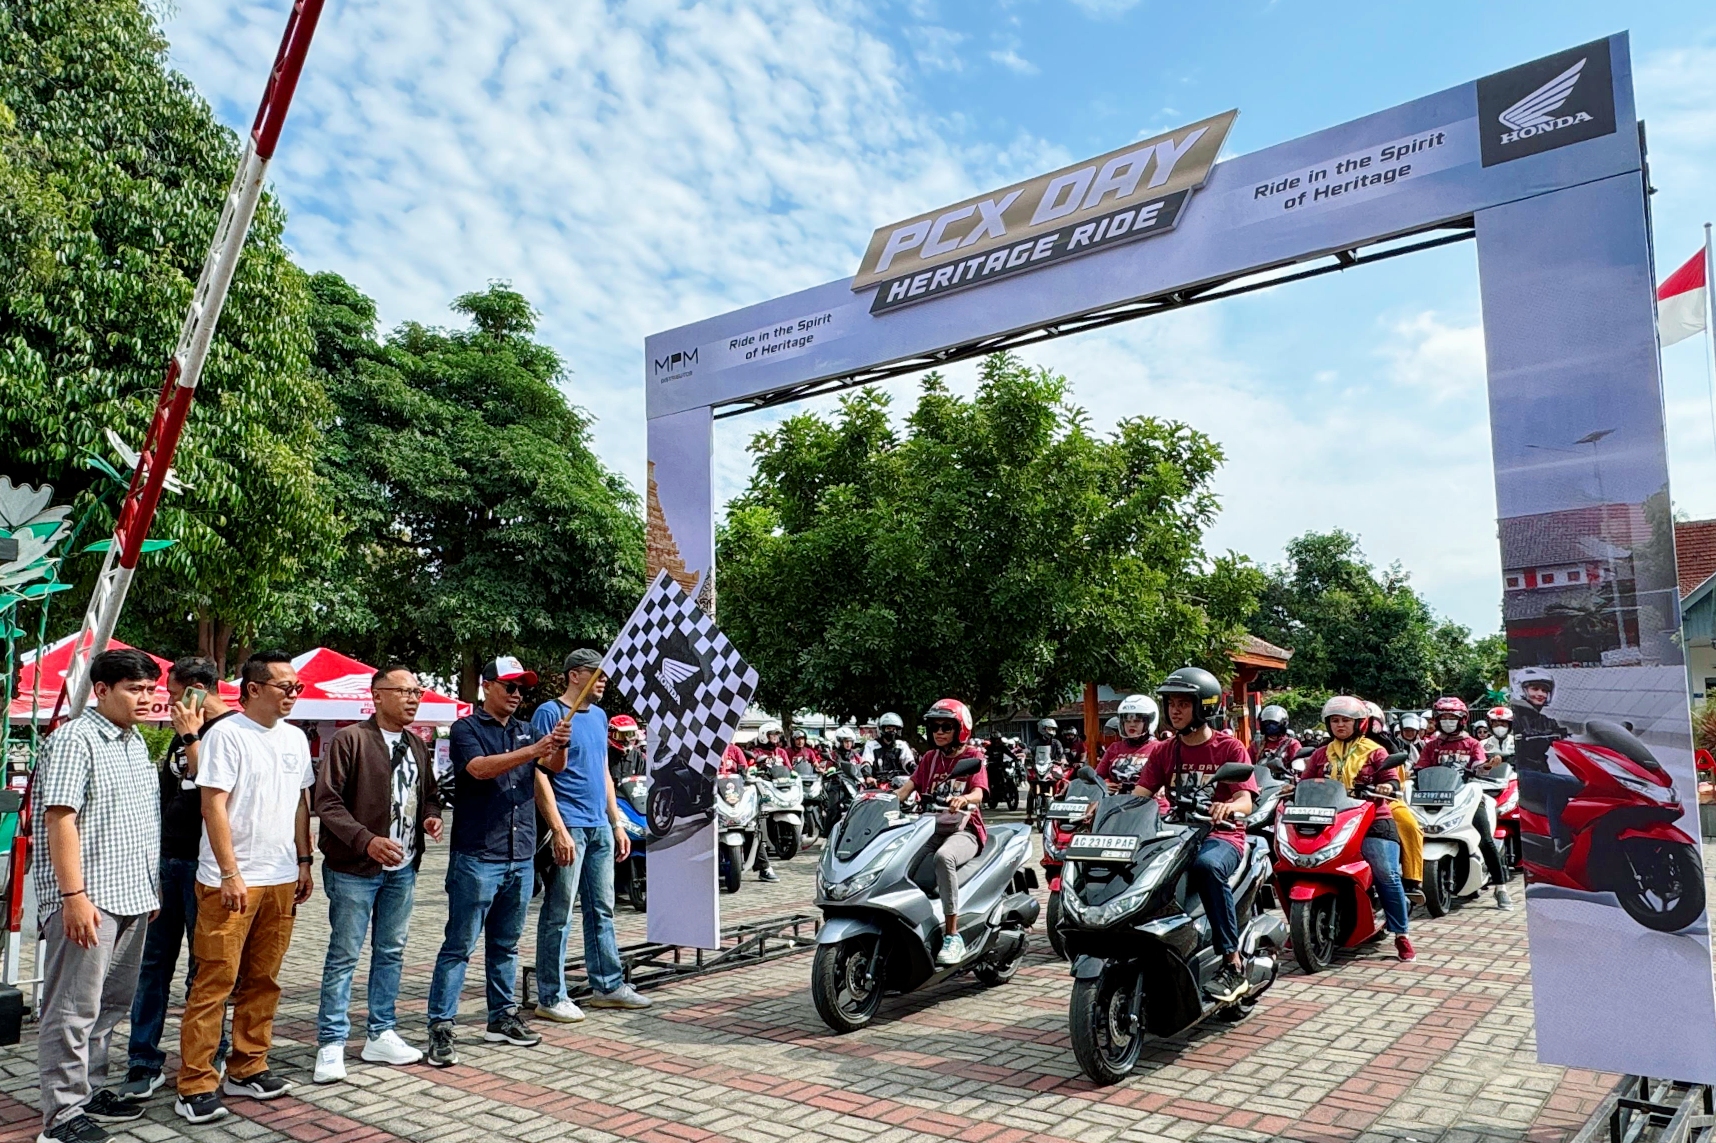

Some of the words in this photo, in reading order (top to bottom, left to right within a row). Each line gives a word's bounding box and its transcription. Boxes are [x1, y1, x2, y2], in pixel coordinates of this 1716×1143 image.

[1500, 111, 1594, 145] HONDA
[1254, 177, 1301, 200] Ride
[1308, 169, 1327, 184] in
[1335, 155, 1372, 175] the
[1379, 131, 1445, 161] Spirit
[874, 188, 1025, 274] PCX
[1029, 126, 1210, 227] DAY
[1284, 191, 1307, 210] of
[1313, 164, 1412, 201] Heritage
[886, 233, 1060, 303] HERITAGE
[1066, 200, 1165, 251] RIDE
[729, 335, 755, 350] Ride
[759, 332, 770, 342] in
[773, 325, 793, 338] the
[797, 313, 832, 331] Spirit
[745, 347, 758, 360] of
[761, 334, 814, 356] Heritage
[655, 347, 698, 376] MPM
[654, 669, 681, 706] HONDA
[1073, 837, 1087, 847] AG
[1088, 837, 1112, 848] 2318
[1114, 838, 1135, 849] PAF
